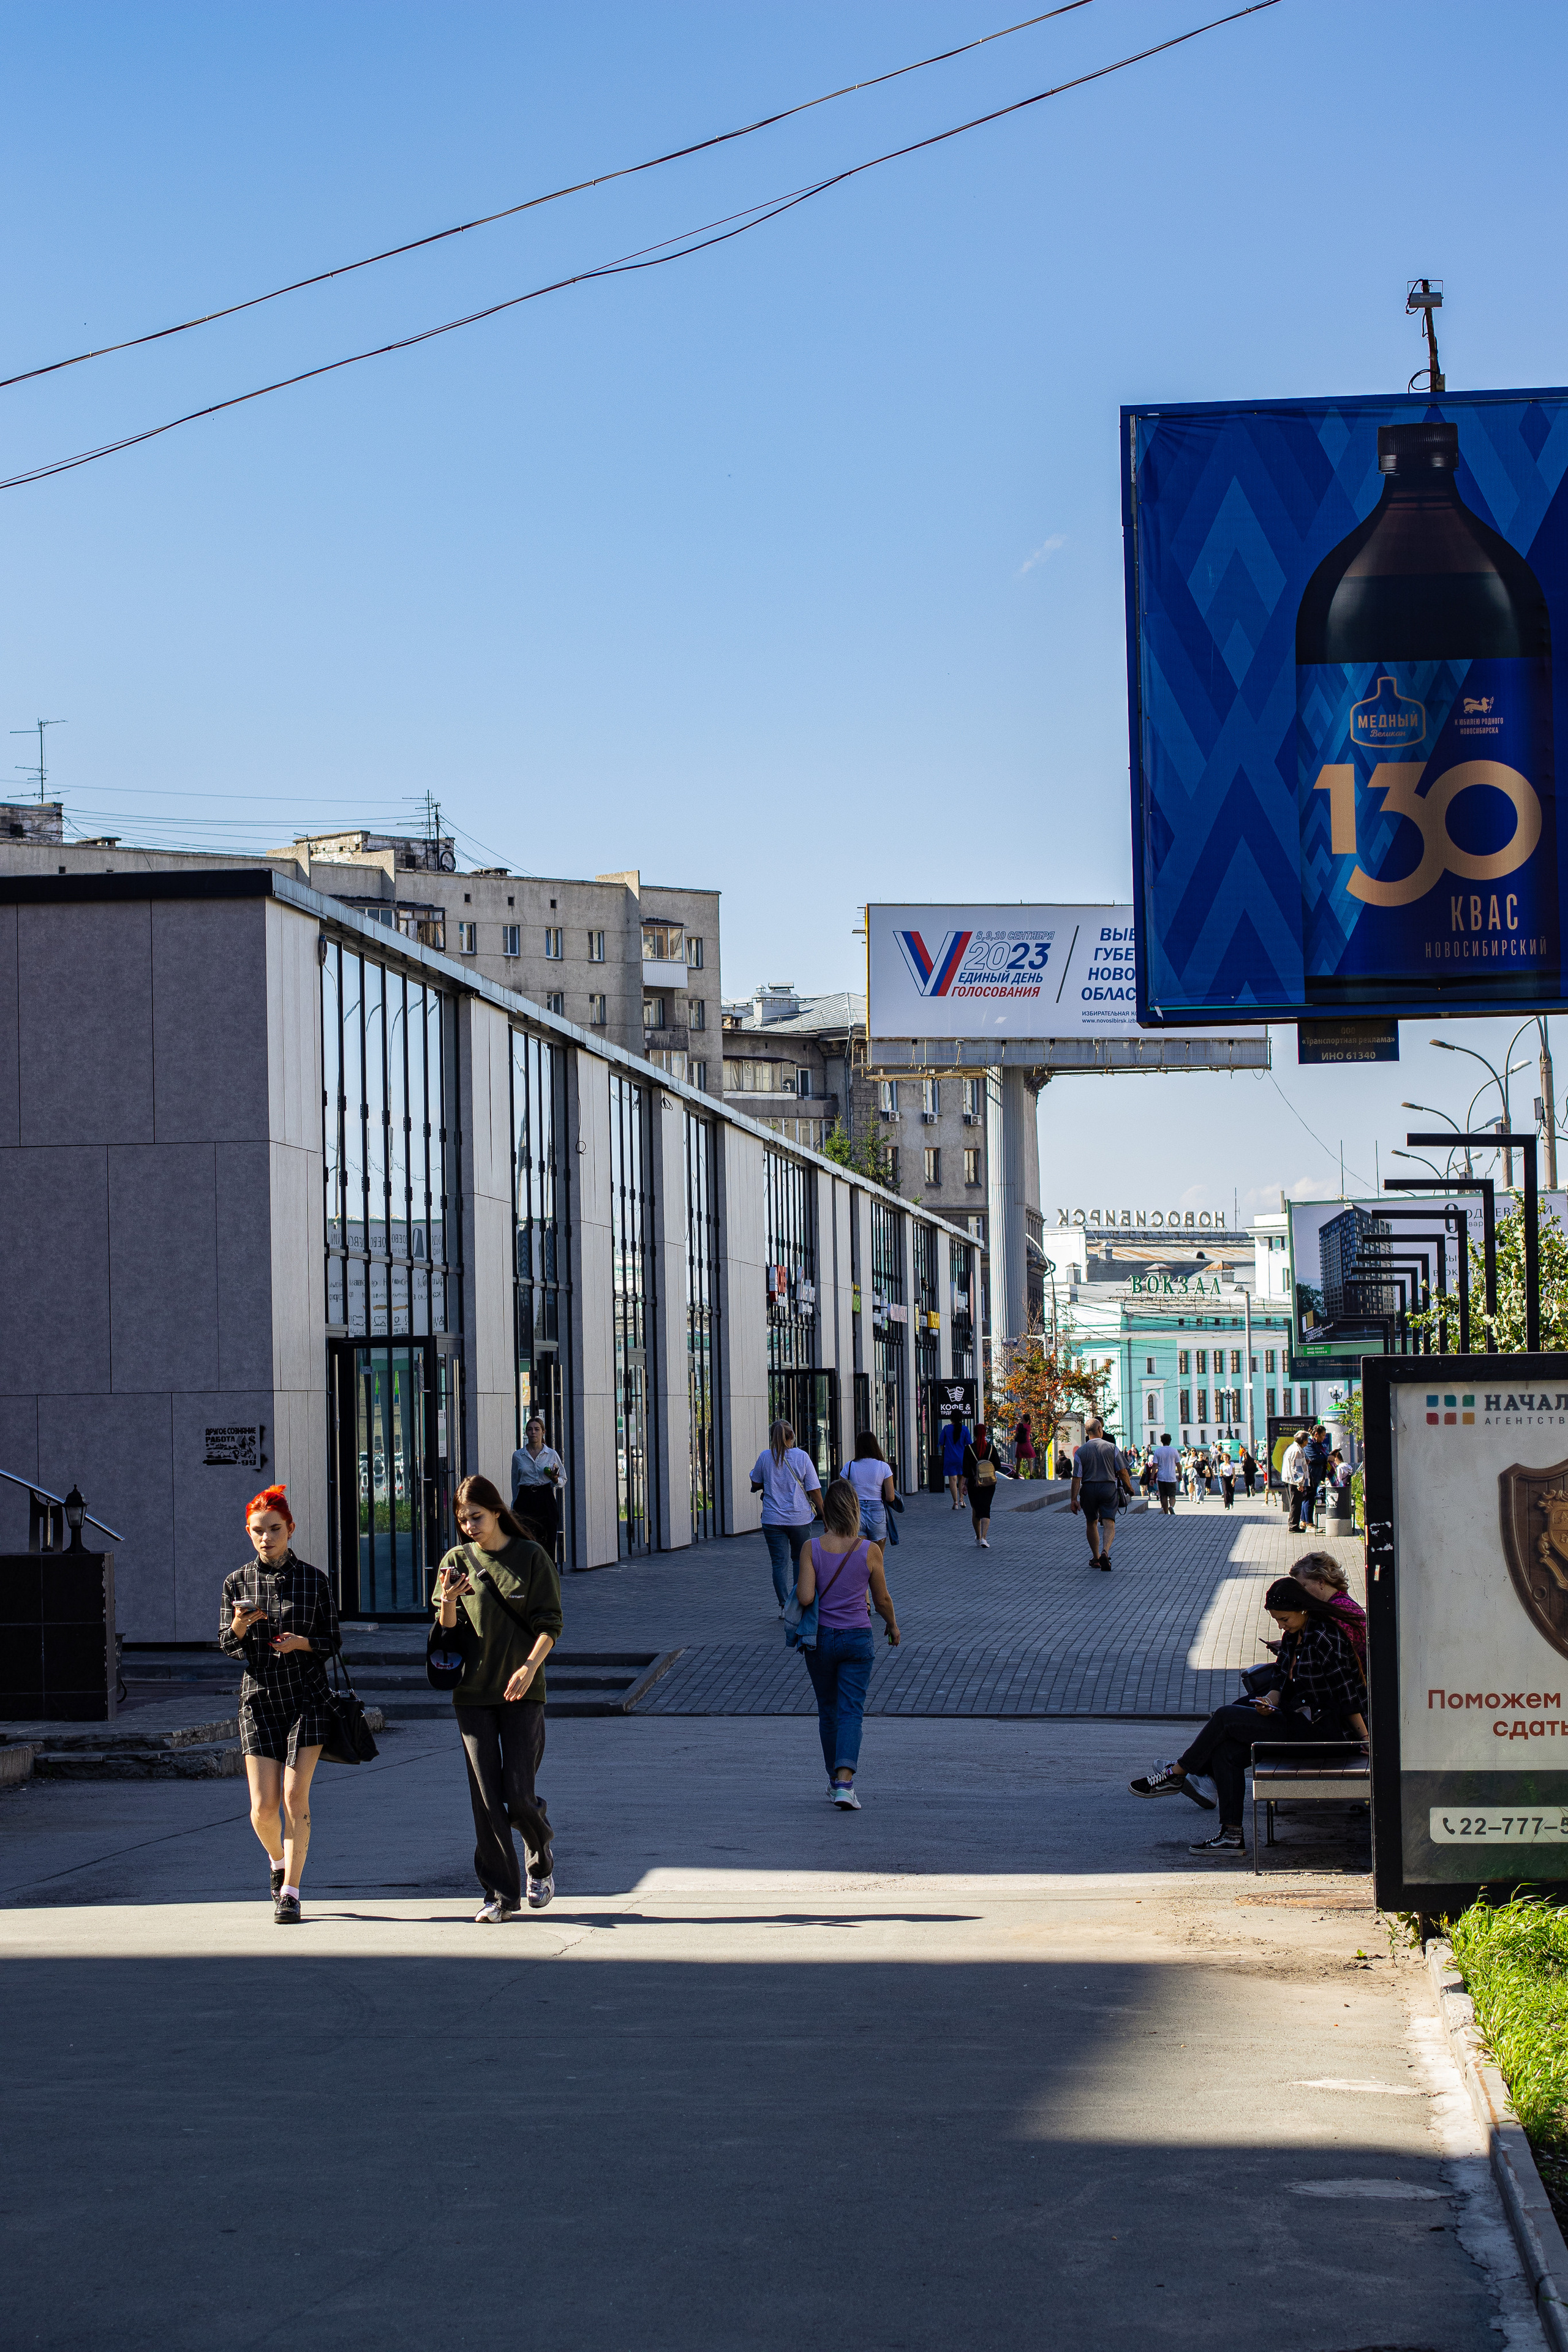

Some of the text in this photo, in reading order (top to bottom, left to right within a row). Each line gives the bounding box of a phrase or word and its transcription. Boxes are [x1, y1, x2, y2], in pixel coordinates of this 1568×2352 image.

[1358, 710, 1418, 729] МЕДНЫЙ
[1370, 728, 1406, 739] Великан
[1313, 759, 1542, 907] 130
[1450, 894, 1519, 932] КВАС
[976, 930, 1055, 941] 8,9,10 СЕНТЯБРЯ
[1093, 948, 1135, 961] ГУБЕ
[1425, 936, 1548, 959] НОВОСИБИРСКИЙ
[963, 941, 1052, 971] 2023
[958, 970, 1044, 985] ЕДИНЫЙ ДЕНЬ
[1088, 967, 1136, 981] НОВО
[951, 986, 1041, 998] ГОЛОСОВАНИЯ
[1081, 987, 1136, 1001] ОБЛАС
[1302, 1036, 1395, 1046] «Транспортная реклама»
[1321, 1052, 1344, 1060] ИНО
[1129, 1275, 1222, 1295] ВОКЗАЛ
[1484, 1394, 1568, 1411] НАЧАЛ
[1428, 1689, 1562, 1709] Поможем
[1492, 1720, 1568, 1740] сдать
